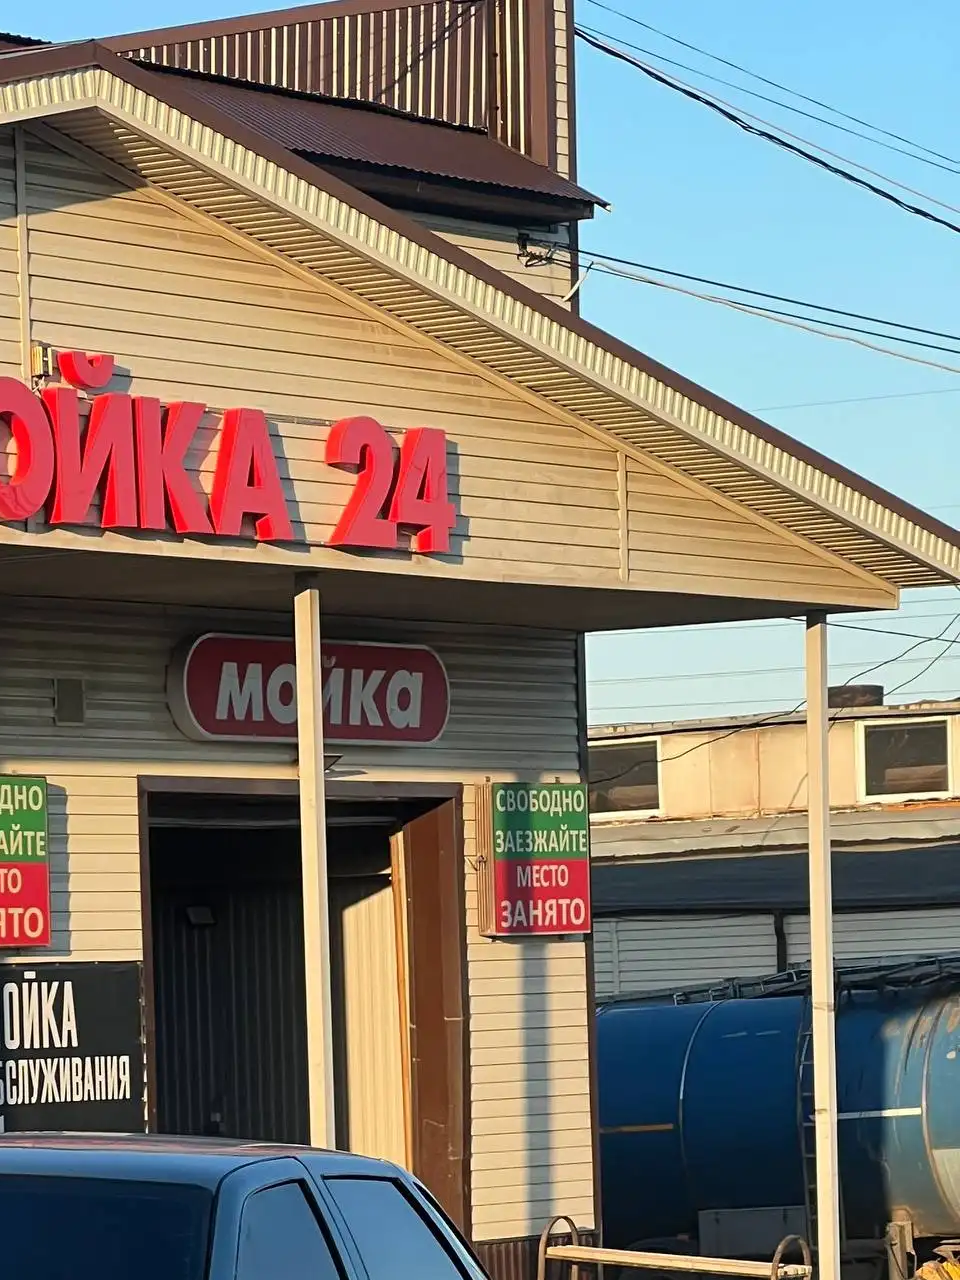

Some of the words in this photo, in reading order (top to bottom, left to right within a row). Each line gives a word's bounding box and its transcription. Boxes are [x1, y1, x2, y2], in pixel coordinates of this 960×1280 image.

[324, 415, 458, 554] 24
[496, 789, 585, 816] СВОБОДНО
[495, 824, 587, 852] ЗАЕЗЖАЙТЕ
[516, 864, 569, 888] МЕСТО
[500, 897, 586, 929] ЗАНЯТО
